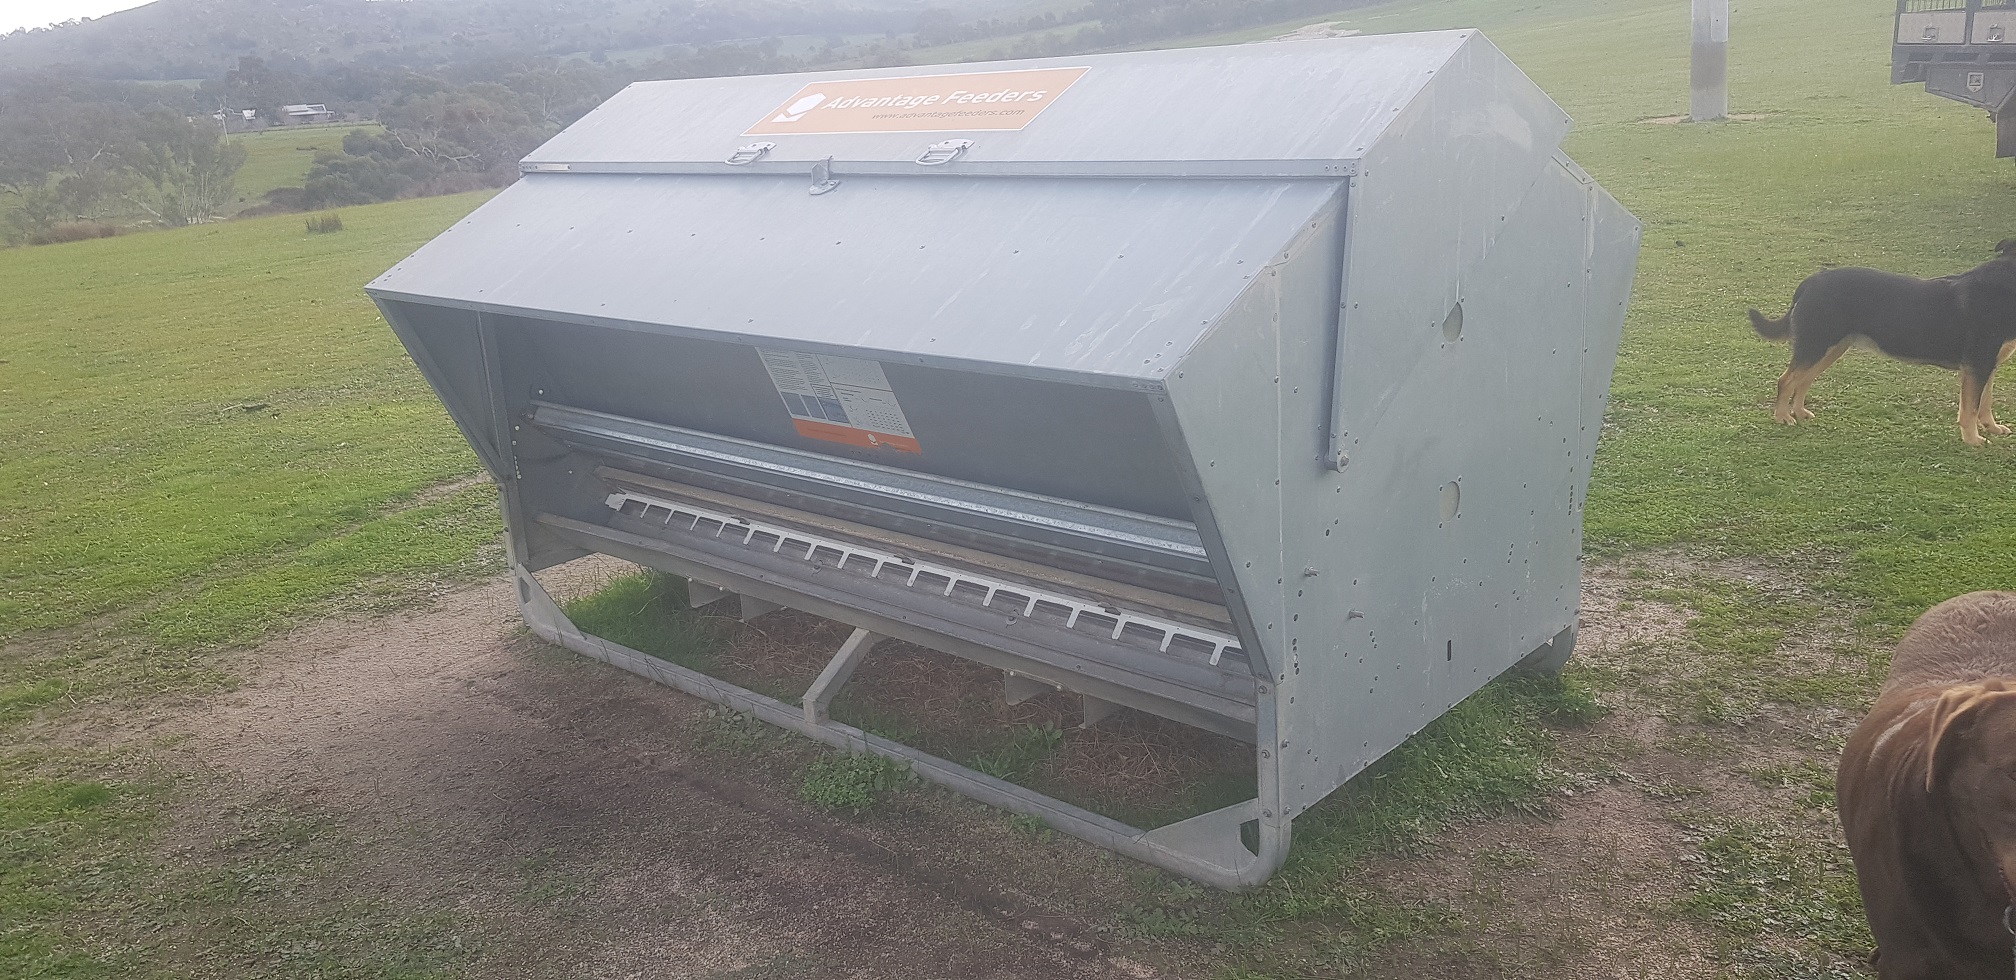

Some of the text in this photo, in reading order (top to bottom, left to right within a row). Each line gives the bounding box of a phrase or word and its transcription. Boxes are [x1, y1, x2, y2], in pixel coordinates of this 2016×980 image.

[821, 88, 1048, 109] Advantage Feeders
[872, 109, 1025, 119] www.advantagefeeders.com
